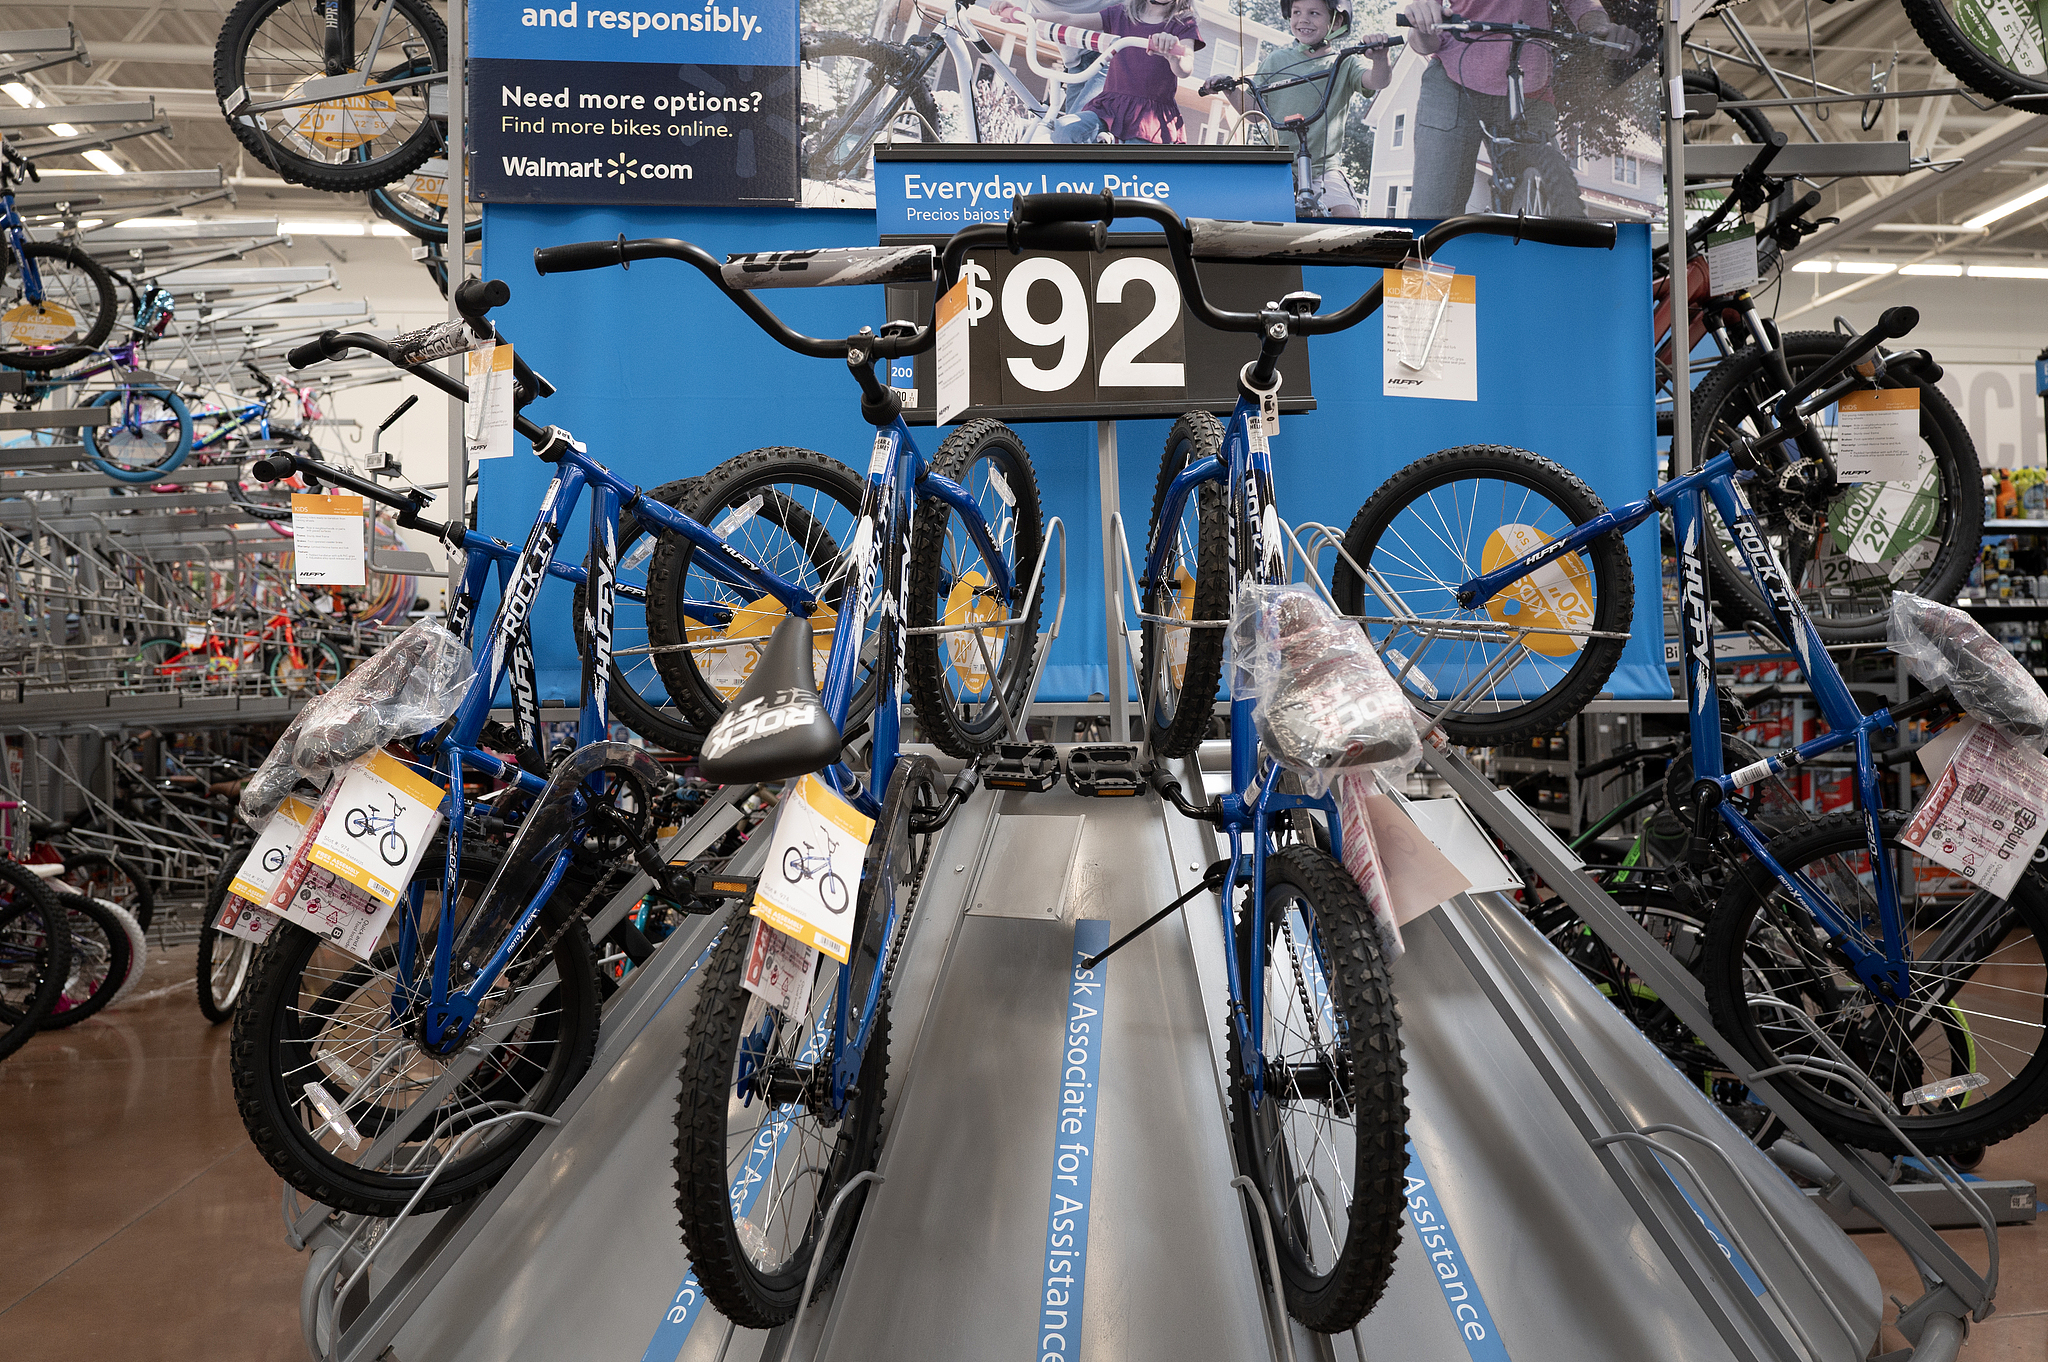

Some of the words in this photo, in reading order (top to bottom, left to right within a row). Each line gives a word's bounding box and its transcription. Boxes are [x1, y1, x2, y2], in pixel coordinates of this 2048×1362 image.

[522, 1, 578, 28] and
[587, 7, 762, 40] responsibly.
[1964, 4, 1990, 40] SCHWINN
[502, 85, 569, 108] Need
[579, 90, 645, 110] more
[654, 91, 763, 116] options?
[300, 114, 335, 130] 20"
[502, 116, 544, 133] Find
[552, 120, 604, 135] more
[611, 119, 661, 136] bikes
[668, 121, 733, 137] online.
[502, 156, 602, 178] Walmart
[640, 161, 692, 180] com
[904, 174, 1032, 206] Everyday
[1104, 174, 1170, 198] Price
[907, 208, 960, 220] Precios
[964, 207, 1000, 223] bajos
[891, 367, 912, 378] 200
[1388, 378, 1424, 386] HUFFY
[1863, 507, 1887, 553] 29"
[1908, 504, 1926, 531] SCHWINN
[721, 543, 761, 572] HUFFY
[1525, 538, 1567, 565] HUFFY
[502, 565, 540, 638] ROCK
[532, 528, 555, 569] IT
[1733, 522, 1780, 582] ROCK
[1769, 587, 1798, 616] IT
[596, 557, 615, 682] HUFFY
[1684, 553, 1710, 670] HUFFY
[1665, 646, 1678, 659] Bi
[707, 705, 815, 761] ROCK
[1998, 826, 2024, 859] BUILD
[316, 850, 332, 860] FREE
[332, 856, 360, 876] ASSEMBLY
[248, 887, 264, 899] ASSEM
[1777, 874, 1793, 892] MOTO
[773, 909, 804, 930] ASSEMBLY
[507, 934, 520, 954] MOTO
[518, 925, 526, 938] X
[1060, 1001, 1098, 1135] Associate
[1055, 1142, 1090, 1186] for
[1403, 1173, 1487, 1342] Assistance
[1040, 1193, 1084, 1362] Assistance
